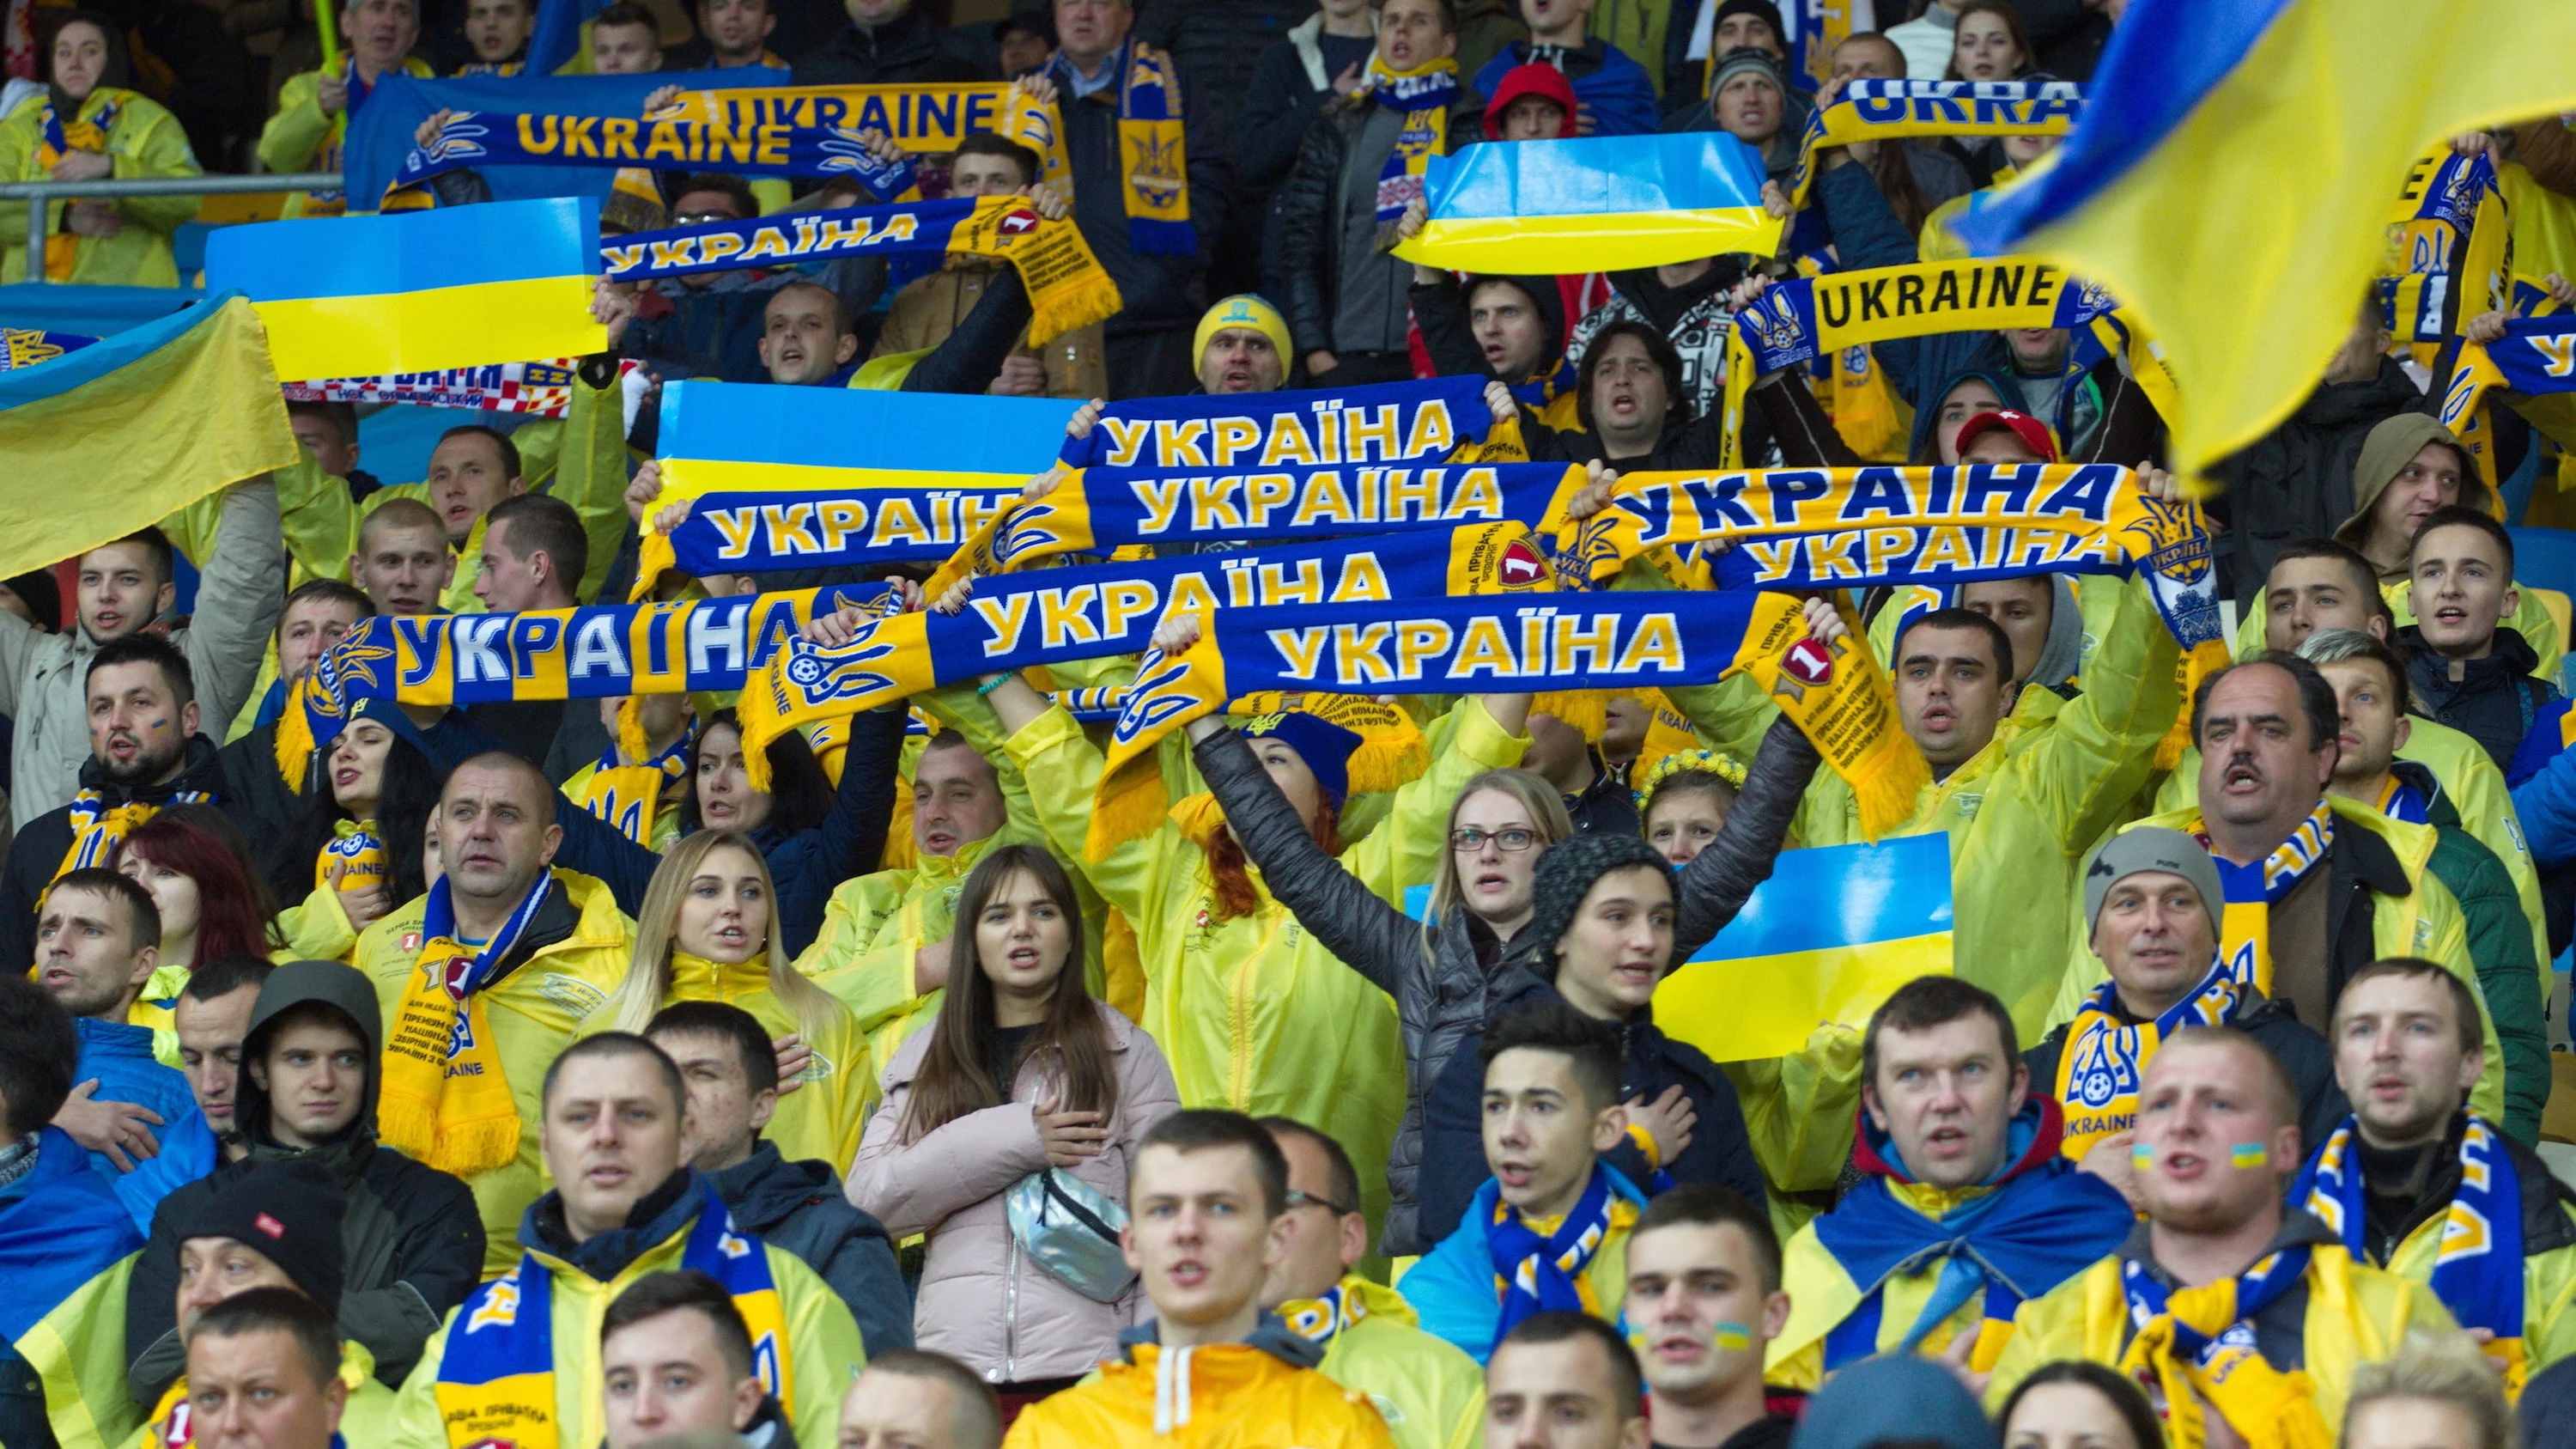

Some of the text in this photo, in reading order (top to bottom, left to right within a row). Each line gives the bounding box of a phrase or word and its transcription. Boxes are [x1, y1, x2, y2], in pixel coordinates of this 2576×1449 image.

[517, 113, 792, 164] UKRAINE
[604, 213, 919, 274] УКРАЇНА
[1820, 264, 2059, 328] UKRAINE
[1097, 399, 1453, 466] УКРАЇНА
[702, 491, 1022, 560] УКРАЇН
[1128, 466, 1504, 536] УКРАЇНА
[969, 551, 1392, 659] УКРАЇНА
[392, 600, 801, 685] УКРАЇНА
[1267, 606, 1685, 685] УКРАЇНА
[1791, 645, 1829, 679] 1
[403, 1013, 445, 1029] ПРЕМІУМ
